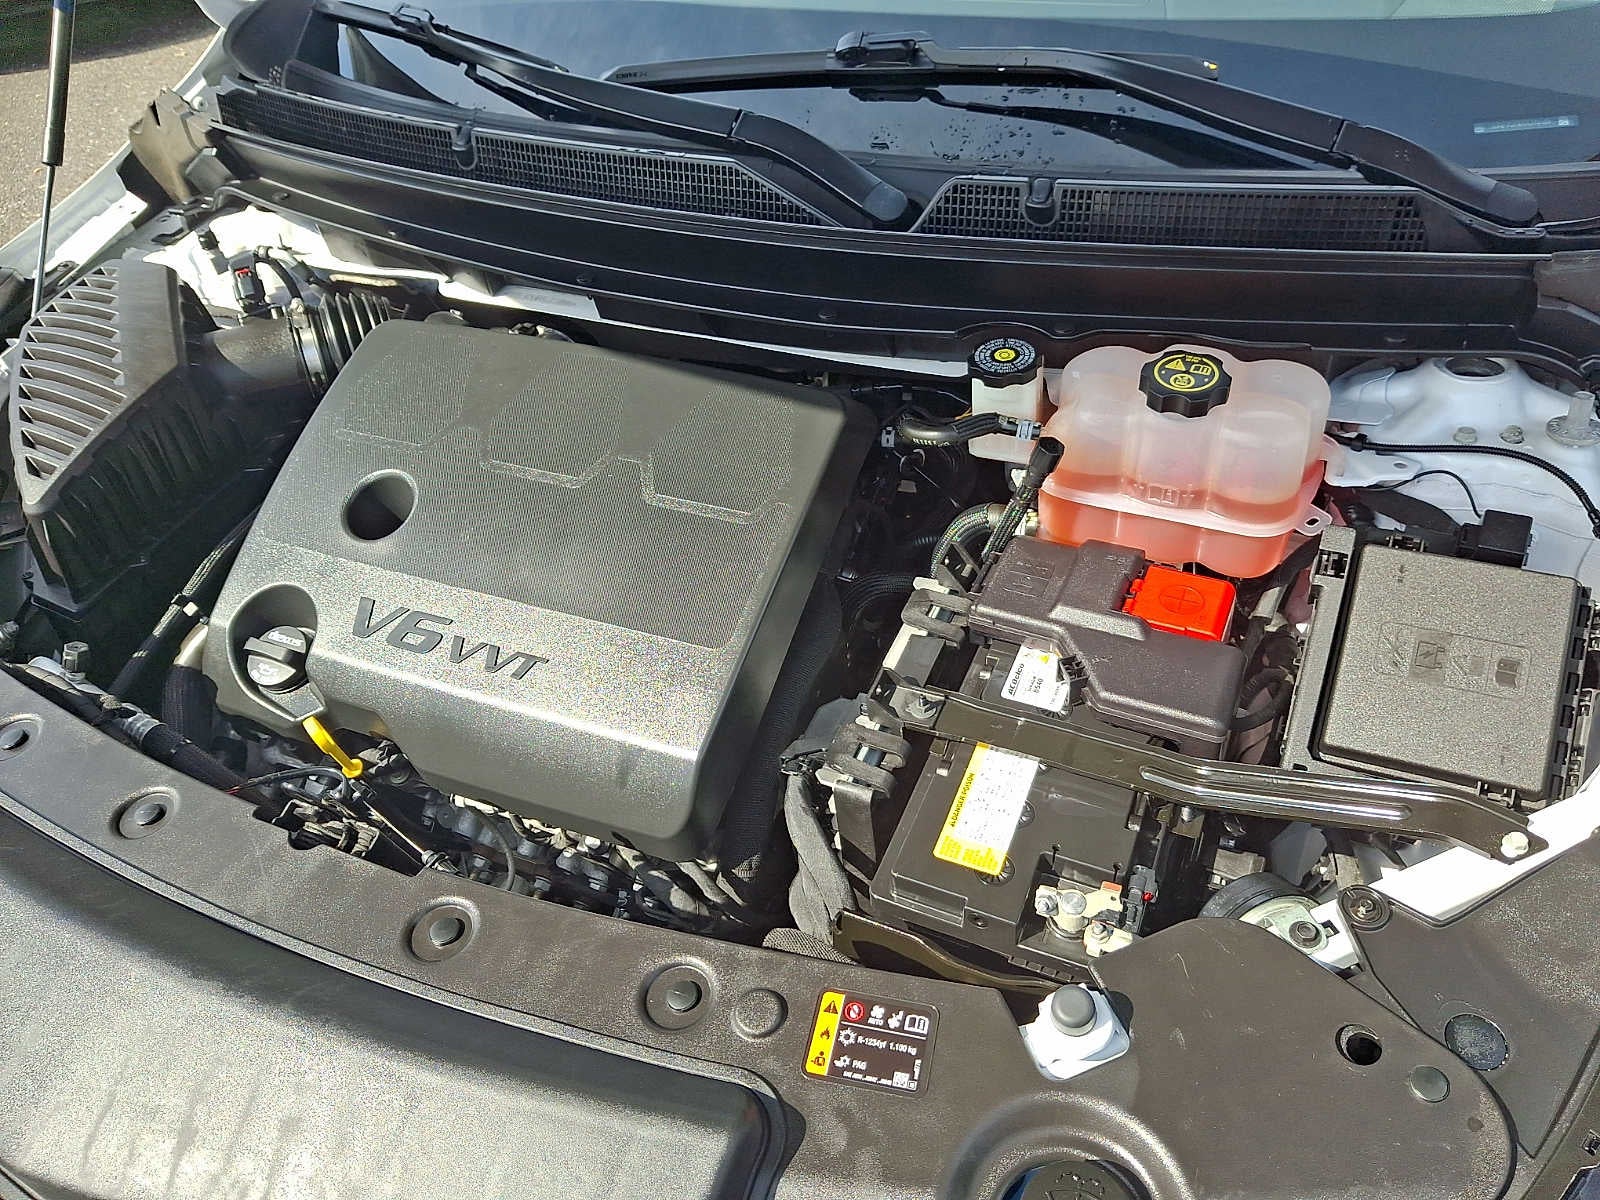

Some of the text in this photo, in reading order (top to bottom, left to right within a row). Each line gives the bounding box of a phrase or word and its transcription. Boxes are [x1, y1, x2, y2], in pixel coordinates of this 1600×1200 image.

[352, 597, 550, 680] V6 VVT
[907, 1046, 918, 1056] kg
